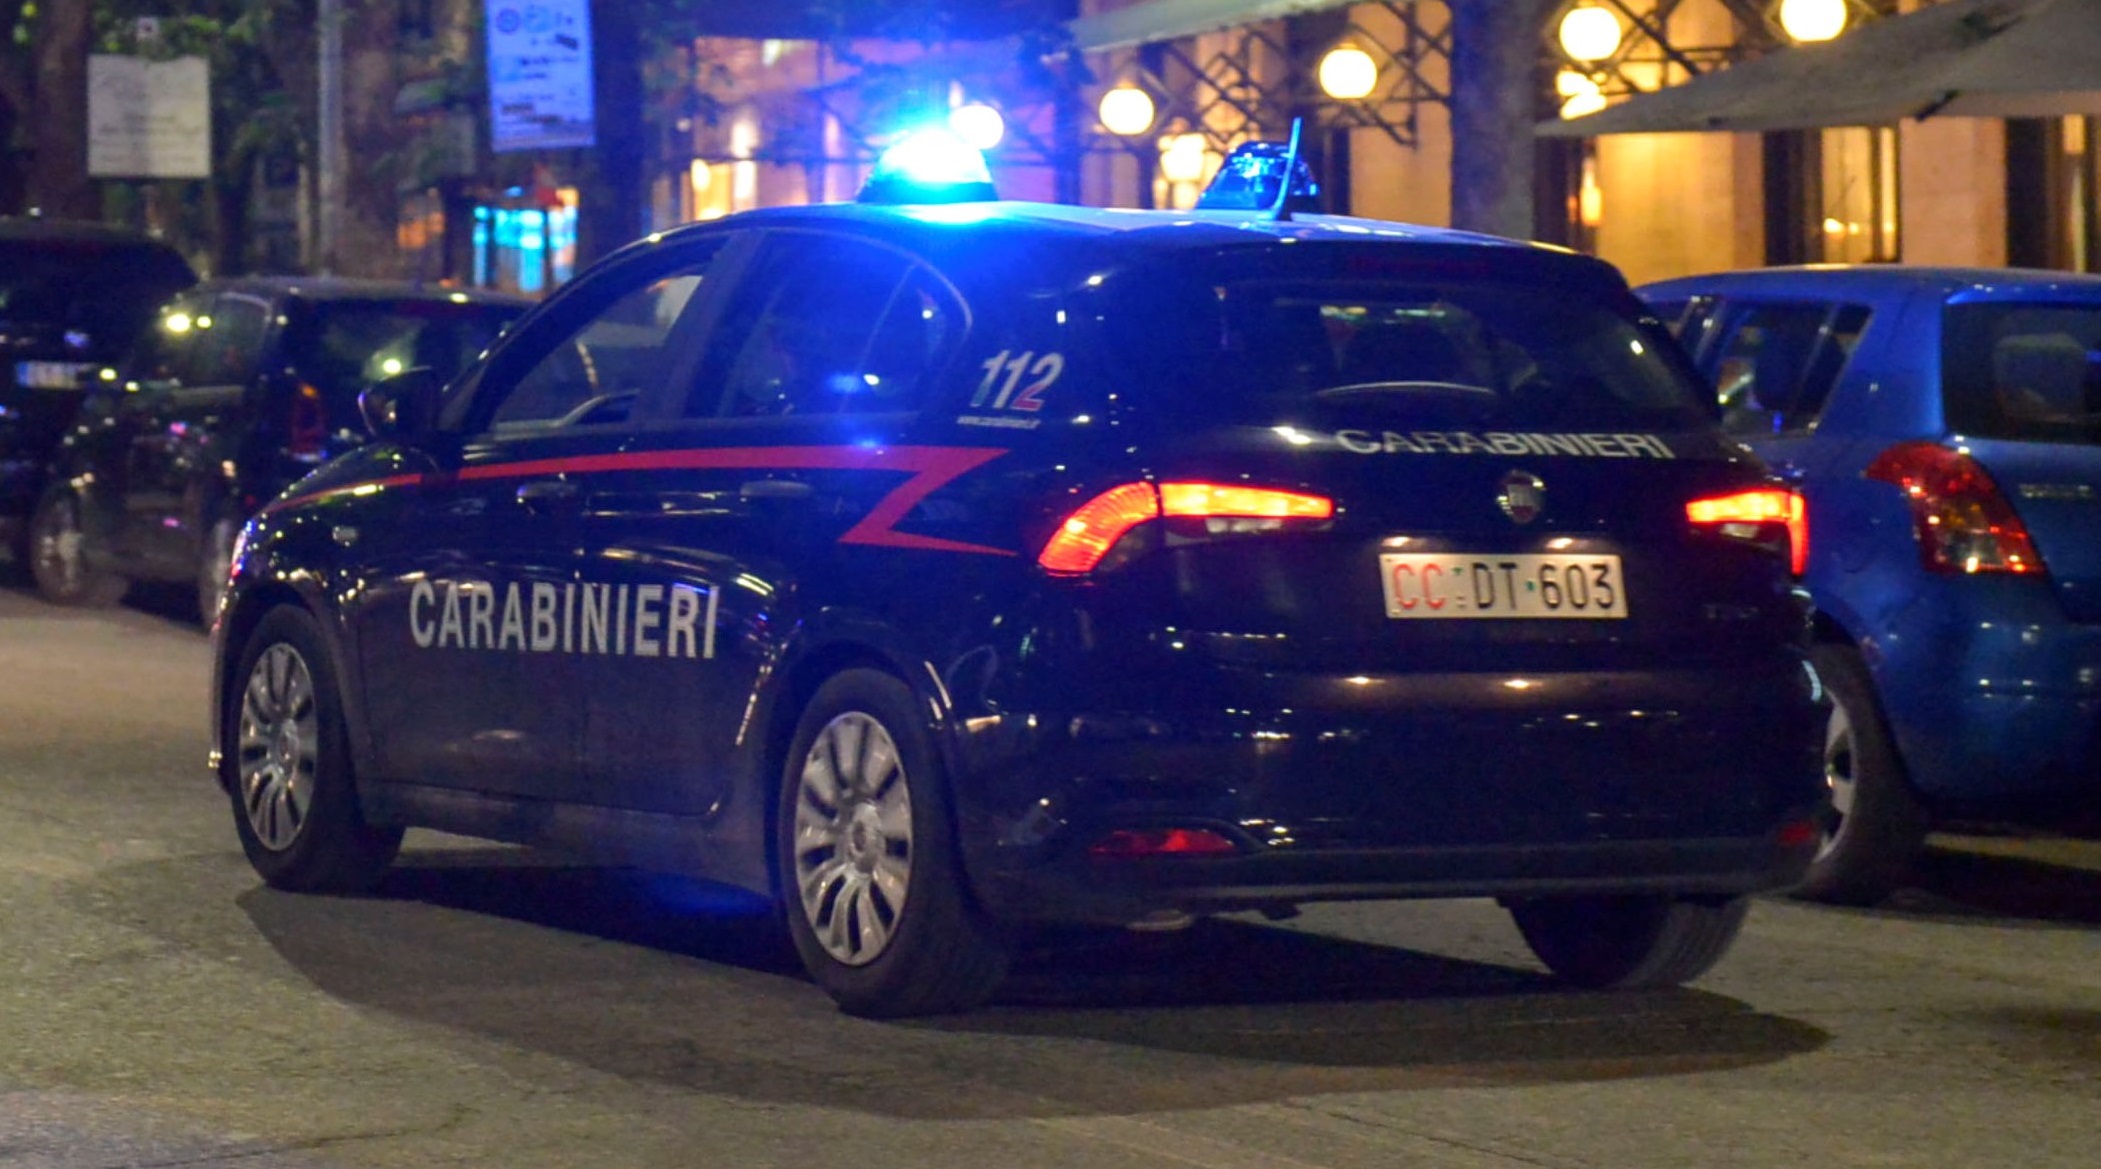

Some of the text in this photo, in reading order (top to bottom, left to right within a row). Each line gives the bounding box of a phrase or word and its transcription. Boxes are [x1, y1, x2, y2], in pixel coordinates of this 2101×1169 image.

[970, 350, 1065, 411] 112
[1336, 430, 1675, 459] CARABINIERI
[1393, 562, 1615, 609] CC DT 603
[410, 579, 719, 658] CARABINIERI
